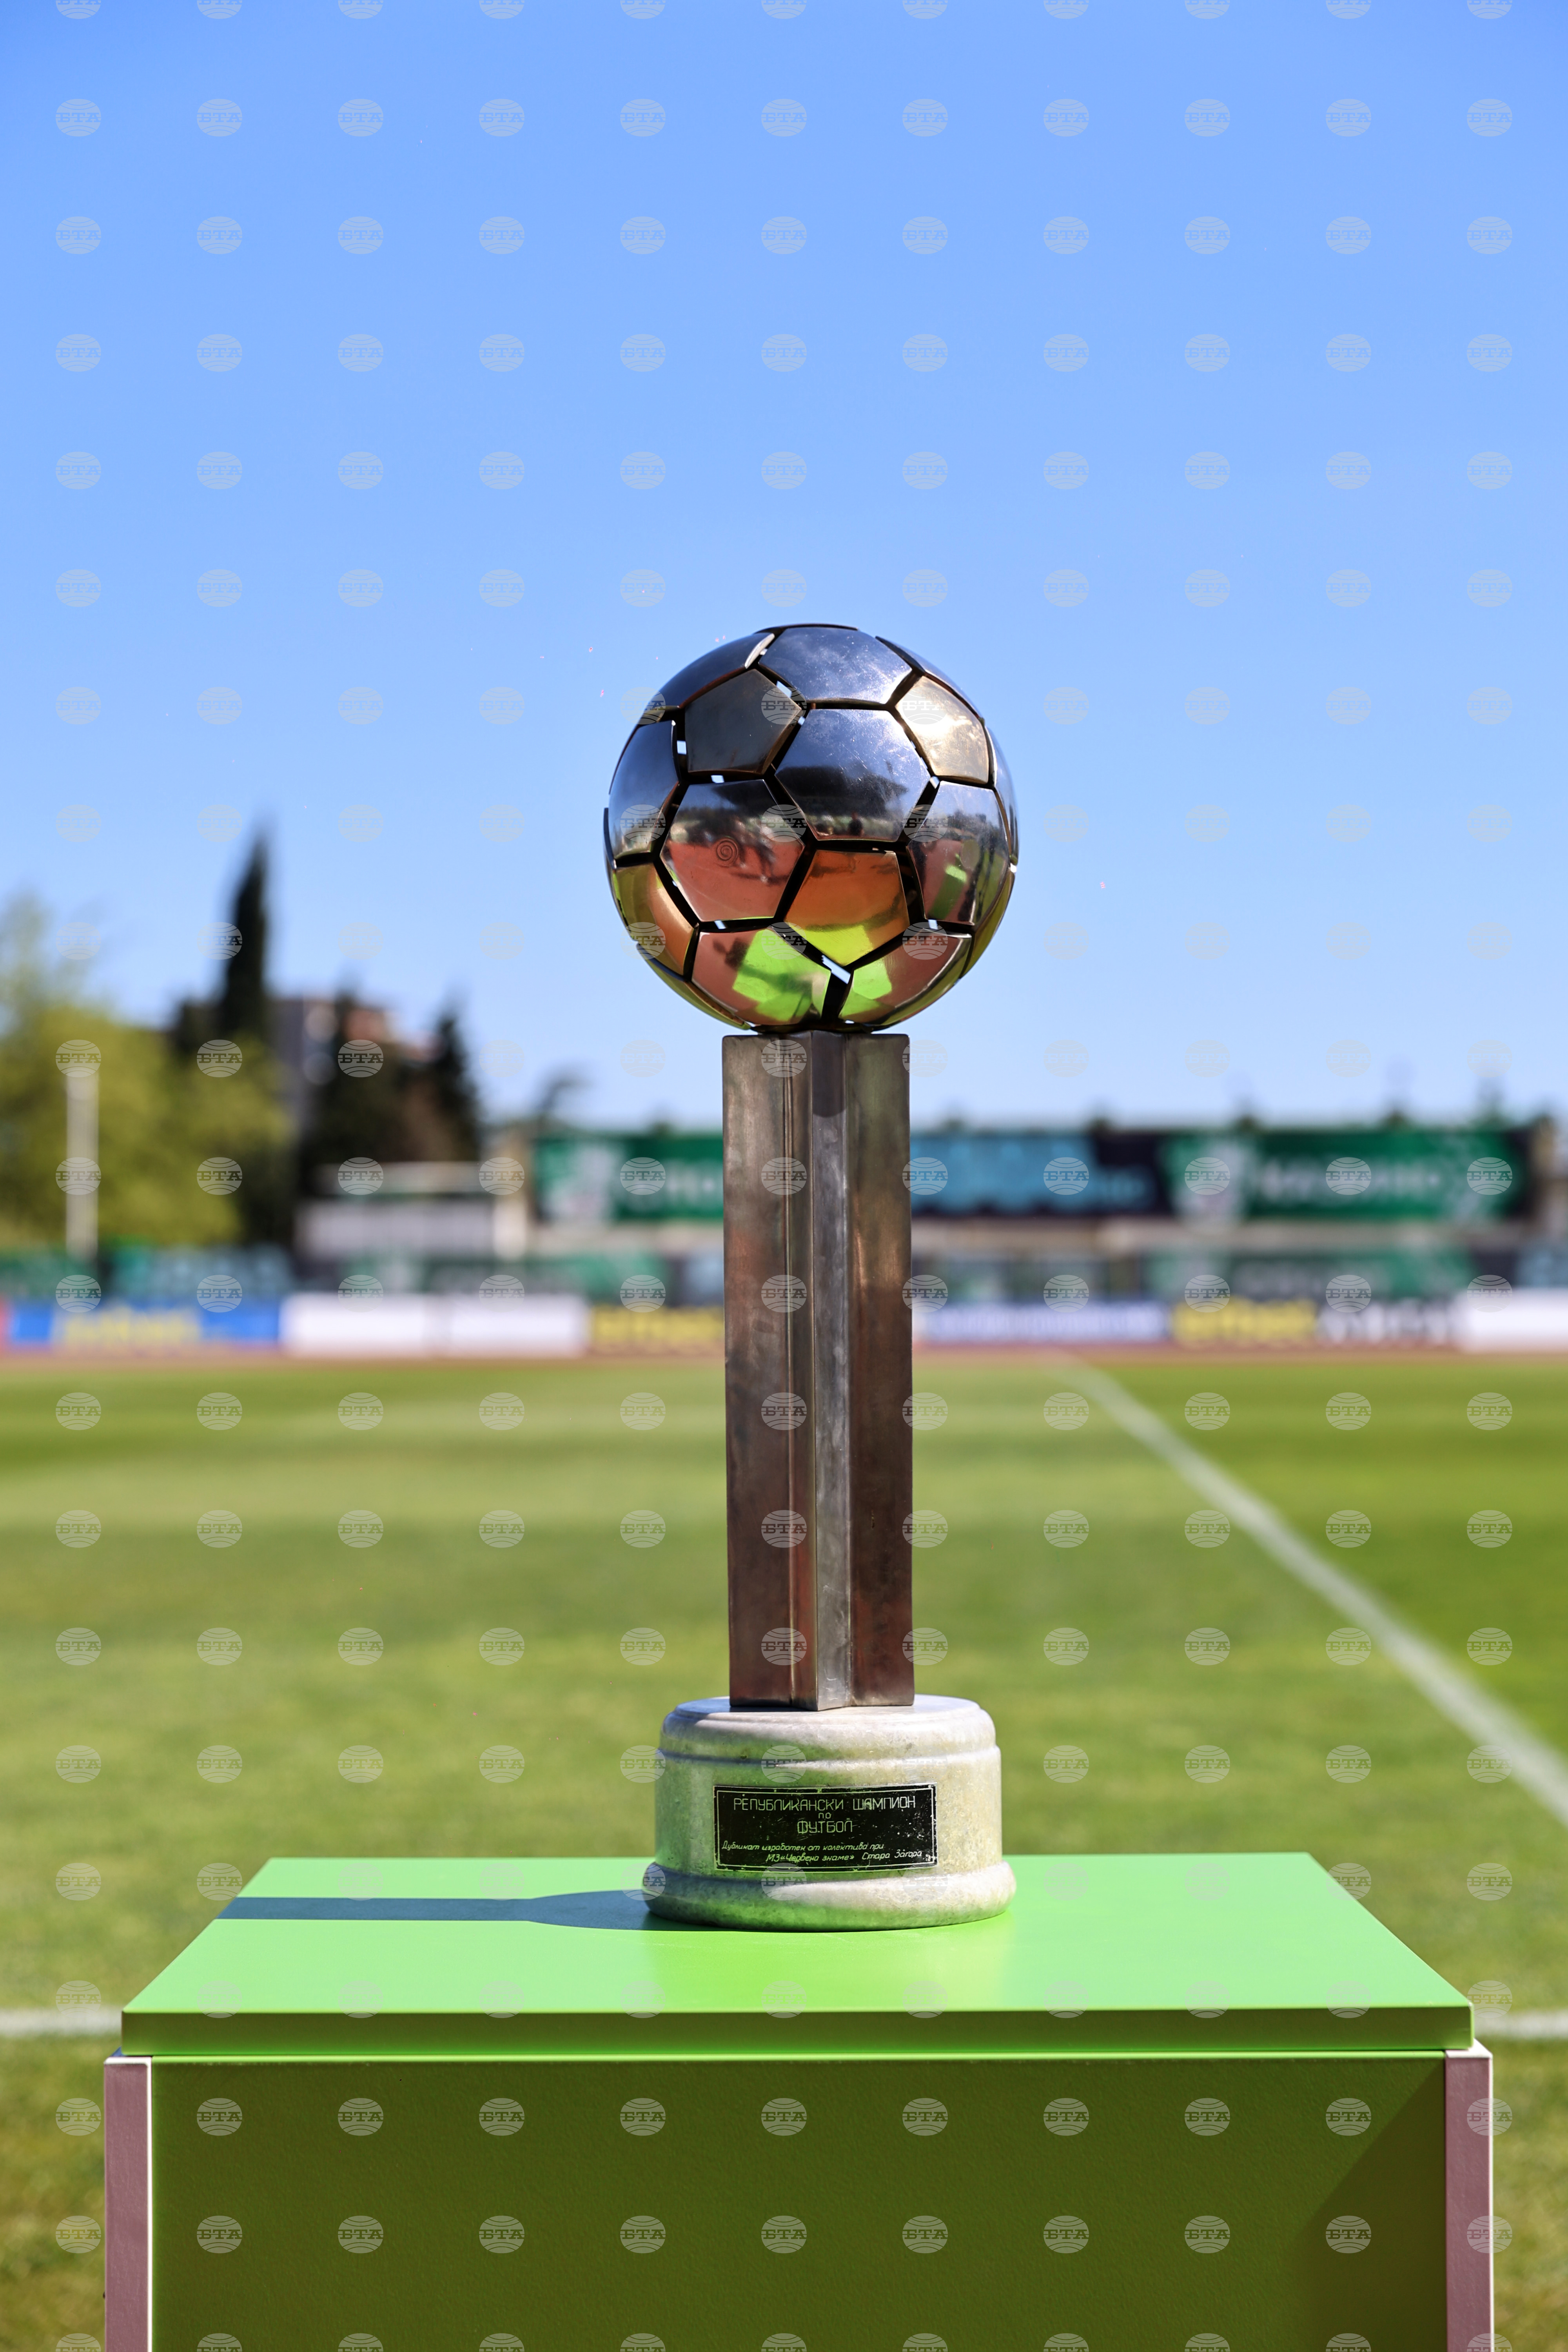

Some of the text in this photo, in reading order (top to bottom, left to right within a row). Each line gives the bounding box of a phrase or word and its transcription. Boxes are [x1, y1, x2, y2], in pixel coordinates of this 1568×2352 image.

[734, 1796, 916, 1811] РЕПУБЛИКАНСКИ ШАМПИОН
[797, 1820, 853, 1834] ФУТБОЛ
[722, 1840, 760, 1850] Дубликат
[762, 1843, 806, 1852] изработен
[823, 1842, 868, 1850] колектива
[862, 1852, 890, 1860] Стара
[895, 1849, 922, 1858] Загора
